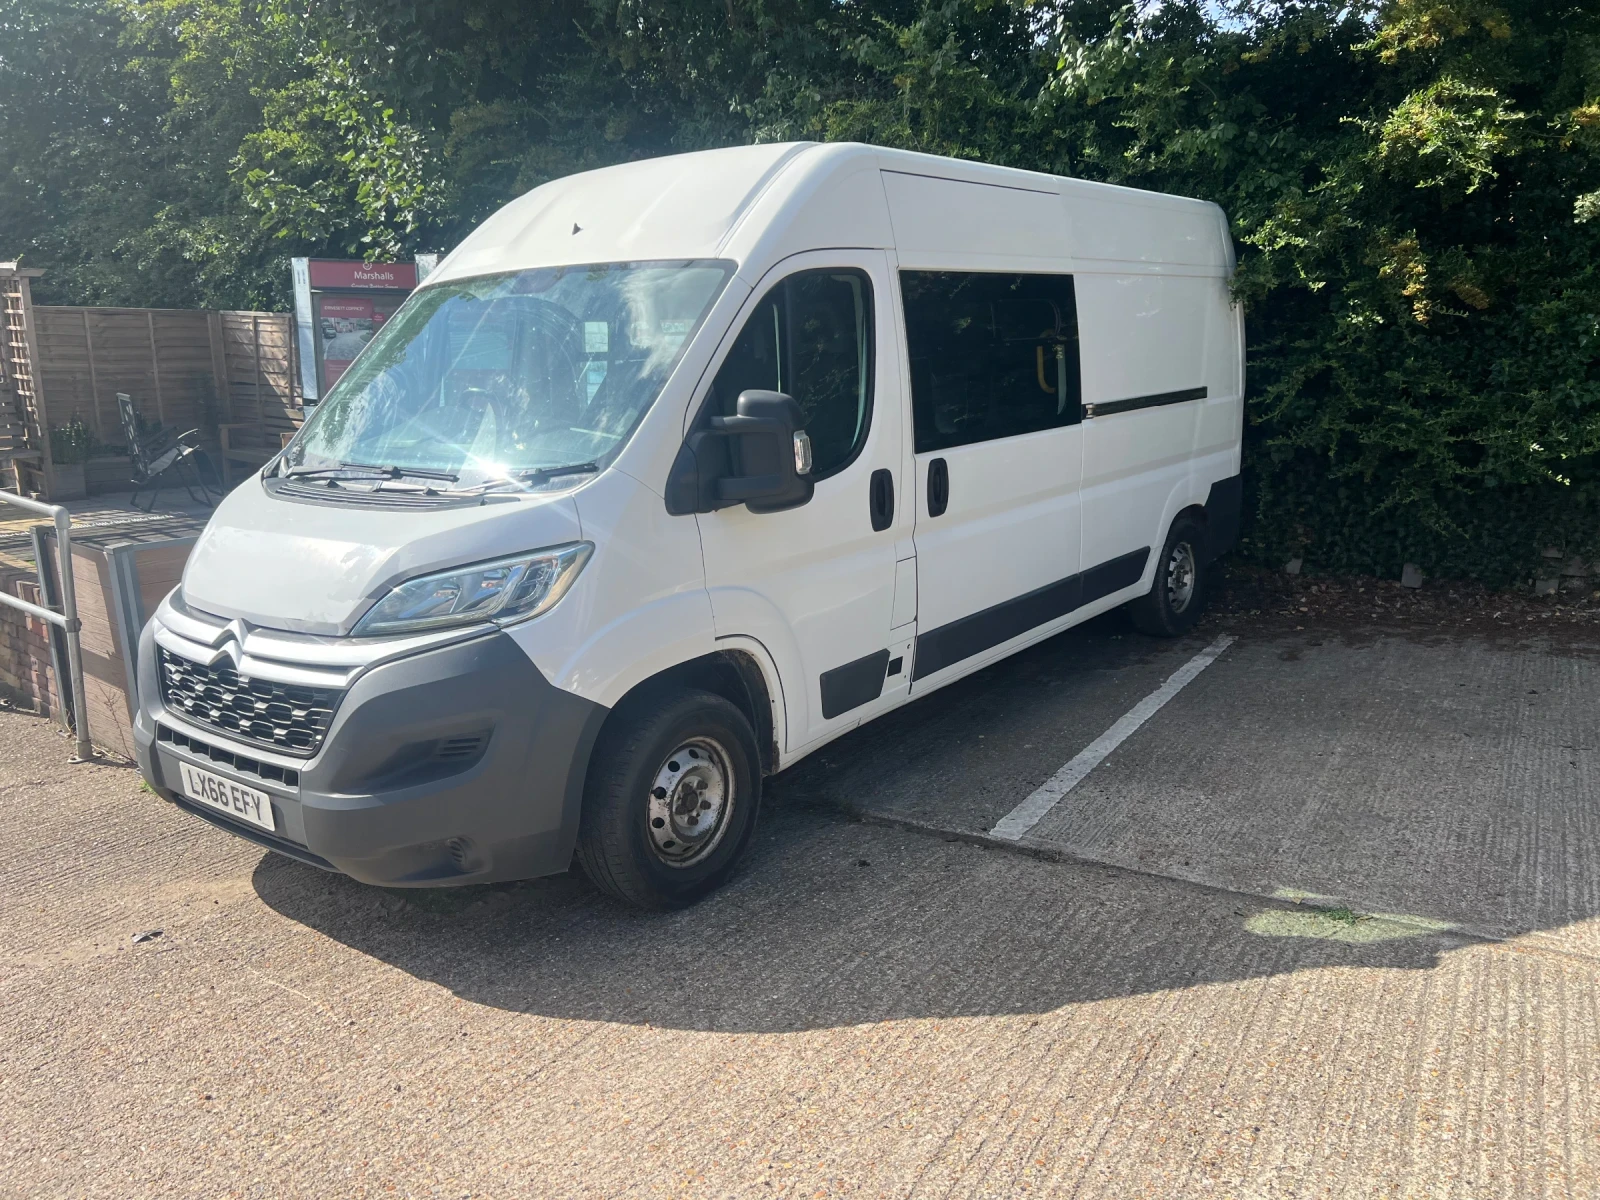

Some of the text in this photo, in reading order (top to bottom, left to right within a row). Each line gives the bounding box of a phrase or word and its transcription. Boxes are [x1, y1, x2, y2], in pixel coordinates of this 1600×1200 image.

[354, 270, 394, 281] Marshalls
[187, 769, 262, 821] LX66 EFY
